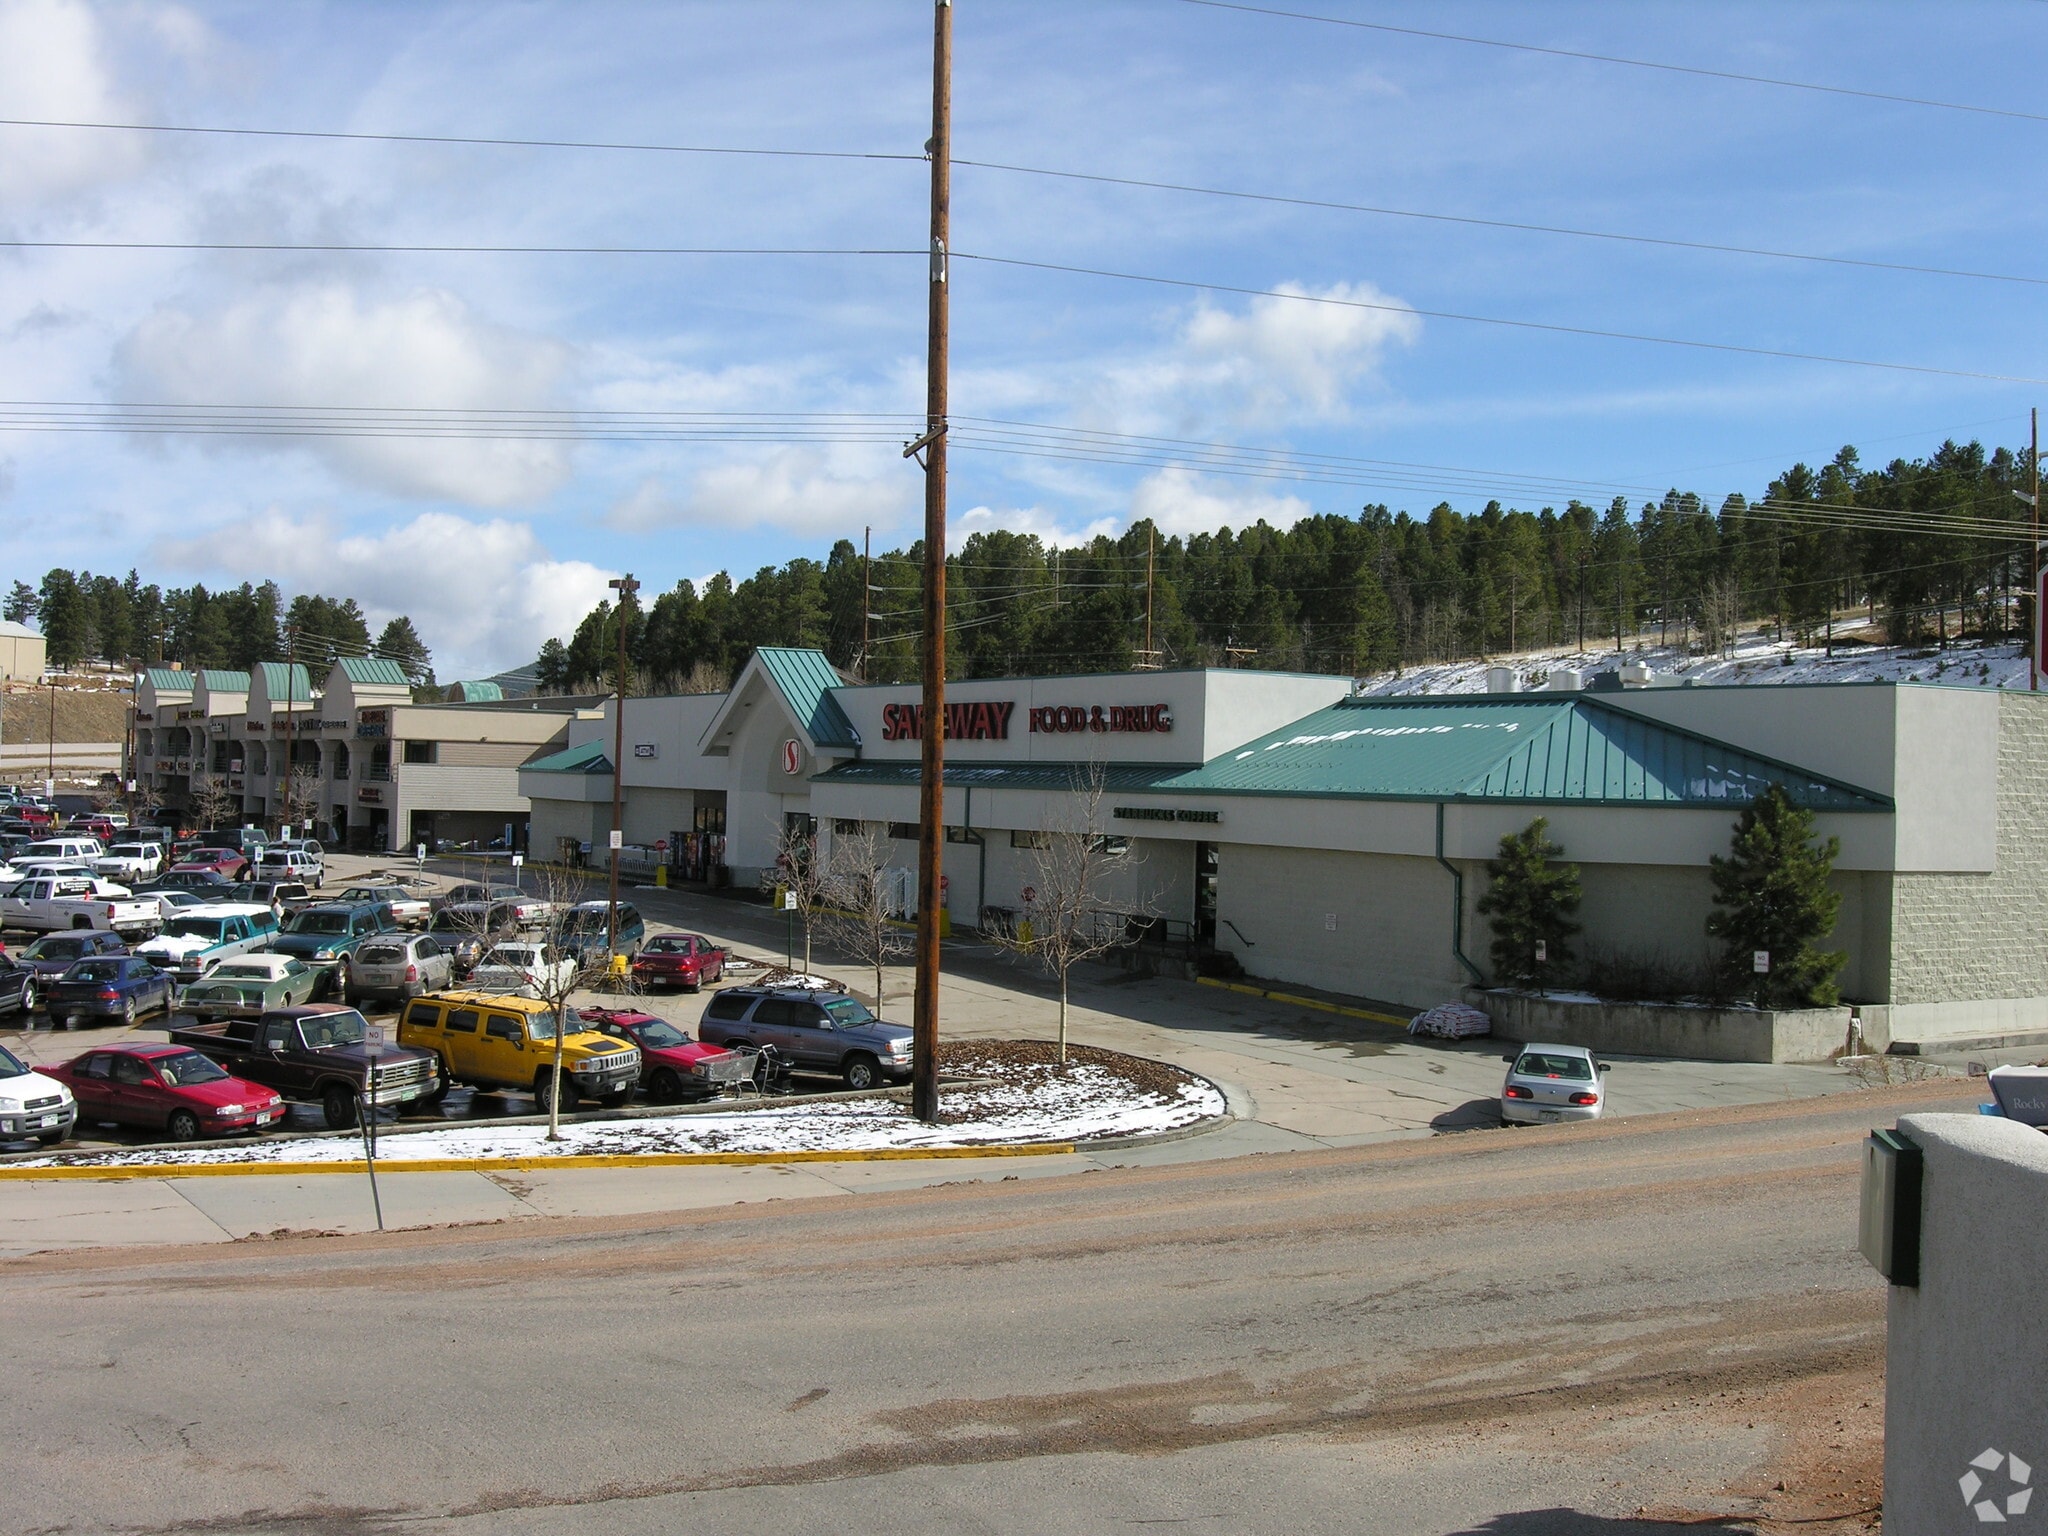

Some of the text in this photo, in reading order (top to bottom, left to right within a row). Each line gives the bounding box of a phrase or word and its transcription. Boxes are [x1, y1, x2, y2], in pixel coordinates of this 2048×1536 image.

[882, 702, 1013, 740] SAWAY
[1029, 704, 1173, 733] FOOD & DRUG
[1113, 807, 1219, 823] STARBUCKS COFFEE
[369, 1031, 379, 1039] NO
